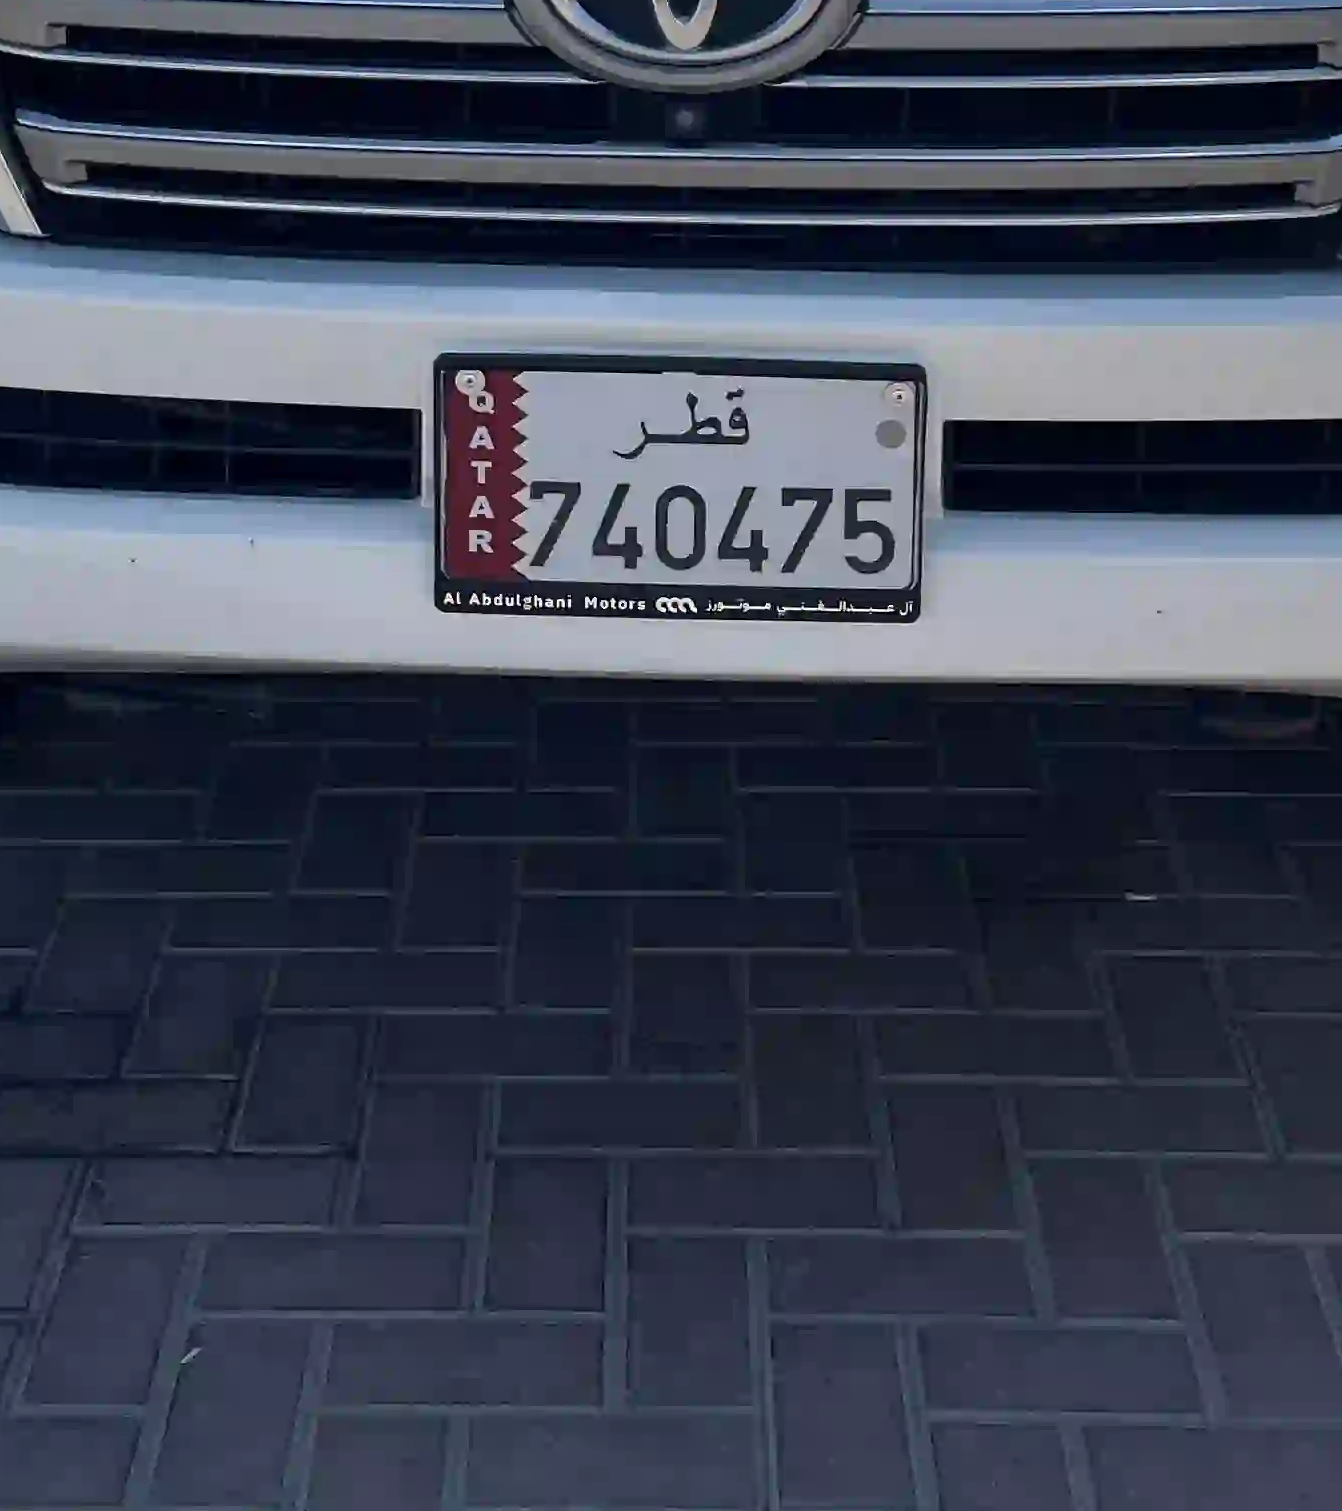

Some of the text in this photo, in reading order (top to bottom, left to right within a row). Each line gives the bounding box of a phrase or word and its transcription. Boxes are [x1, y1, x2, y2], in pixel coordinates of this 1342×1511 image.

[613, 386, 750, 460] قطر
[468, 390, 495, 563] QATAR
[529, 479, 896, 575] 740475
[443, 592, 646, 611] Al Abdulghani Motors
[705, 598, 772, 613] موتورز
